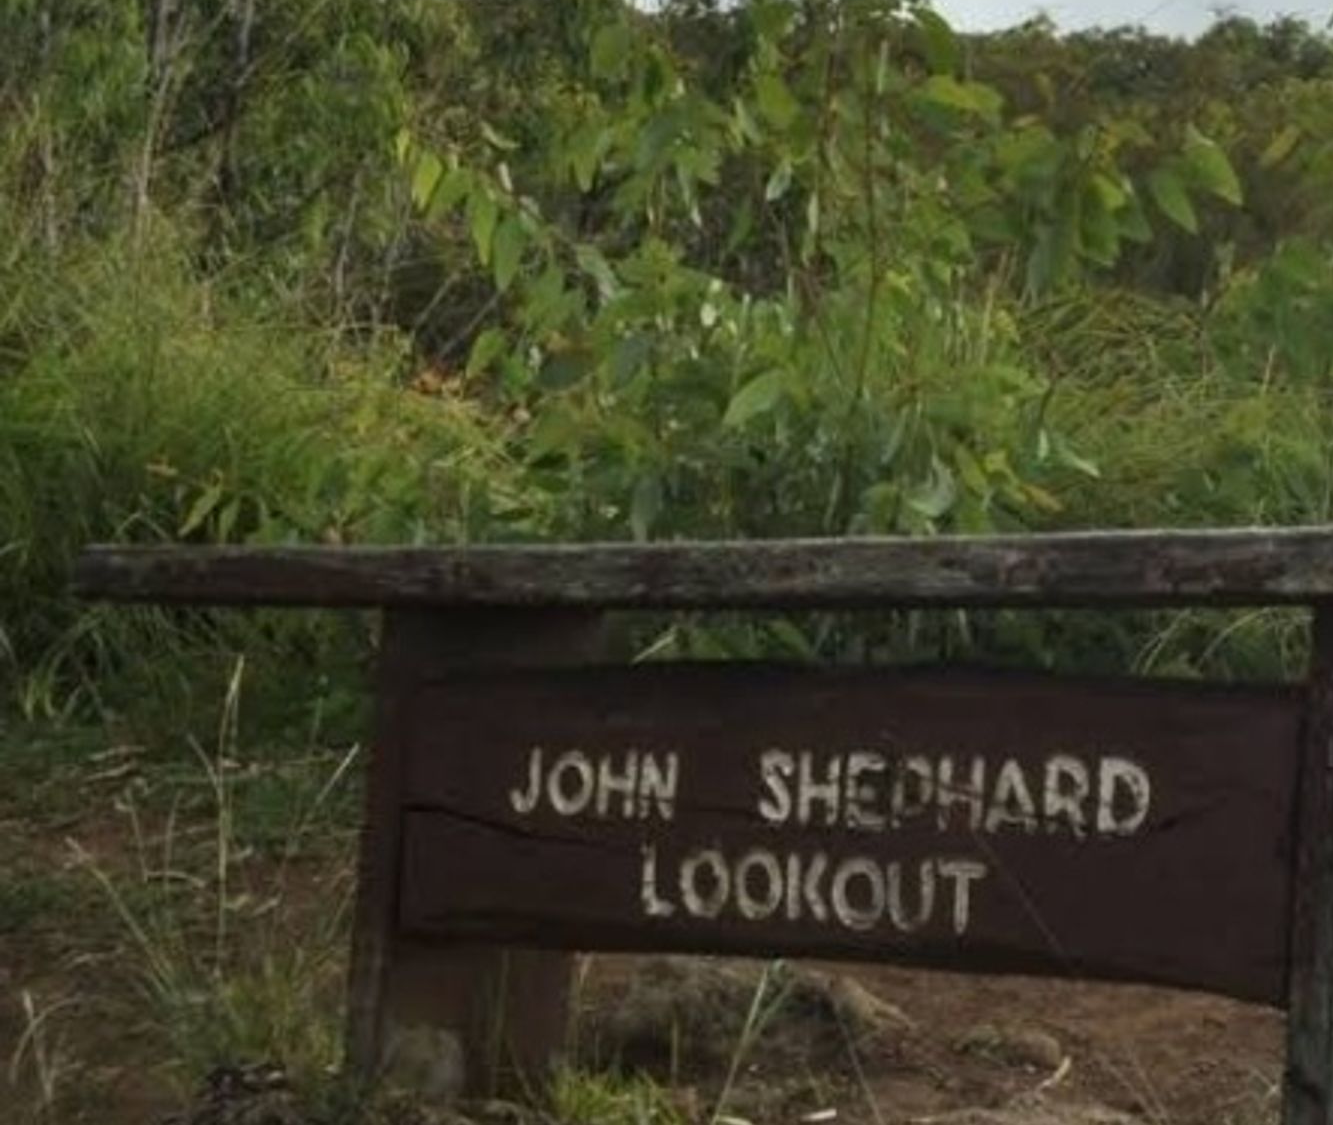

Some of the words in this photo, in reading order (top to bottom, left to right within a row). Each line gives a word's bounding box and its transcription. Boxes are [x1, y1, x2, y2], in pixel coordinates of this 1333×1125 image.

[509, 747, 679, 820] JOHN
[758, 748, 1150, 837] SHEPHARD
[640, 844, 988, 934] LOOKOUT
